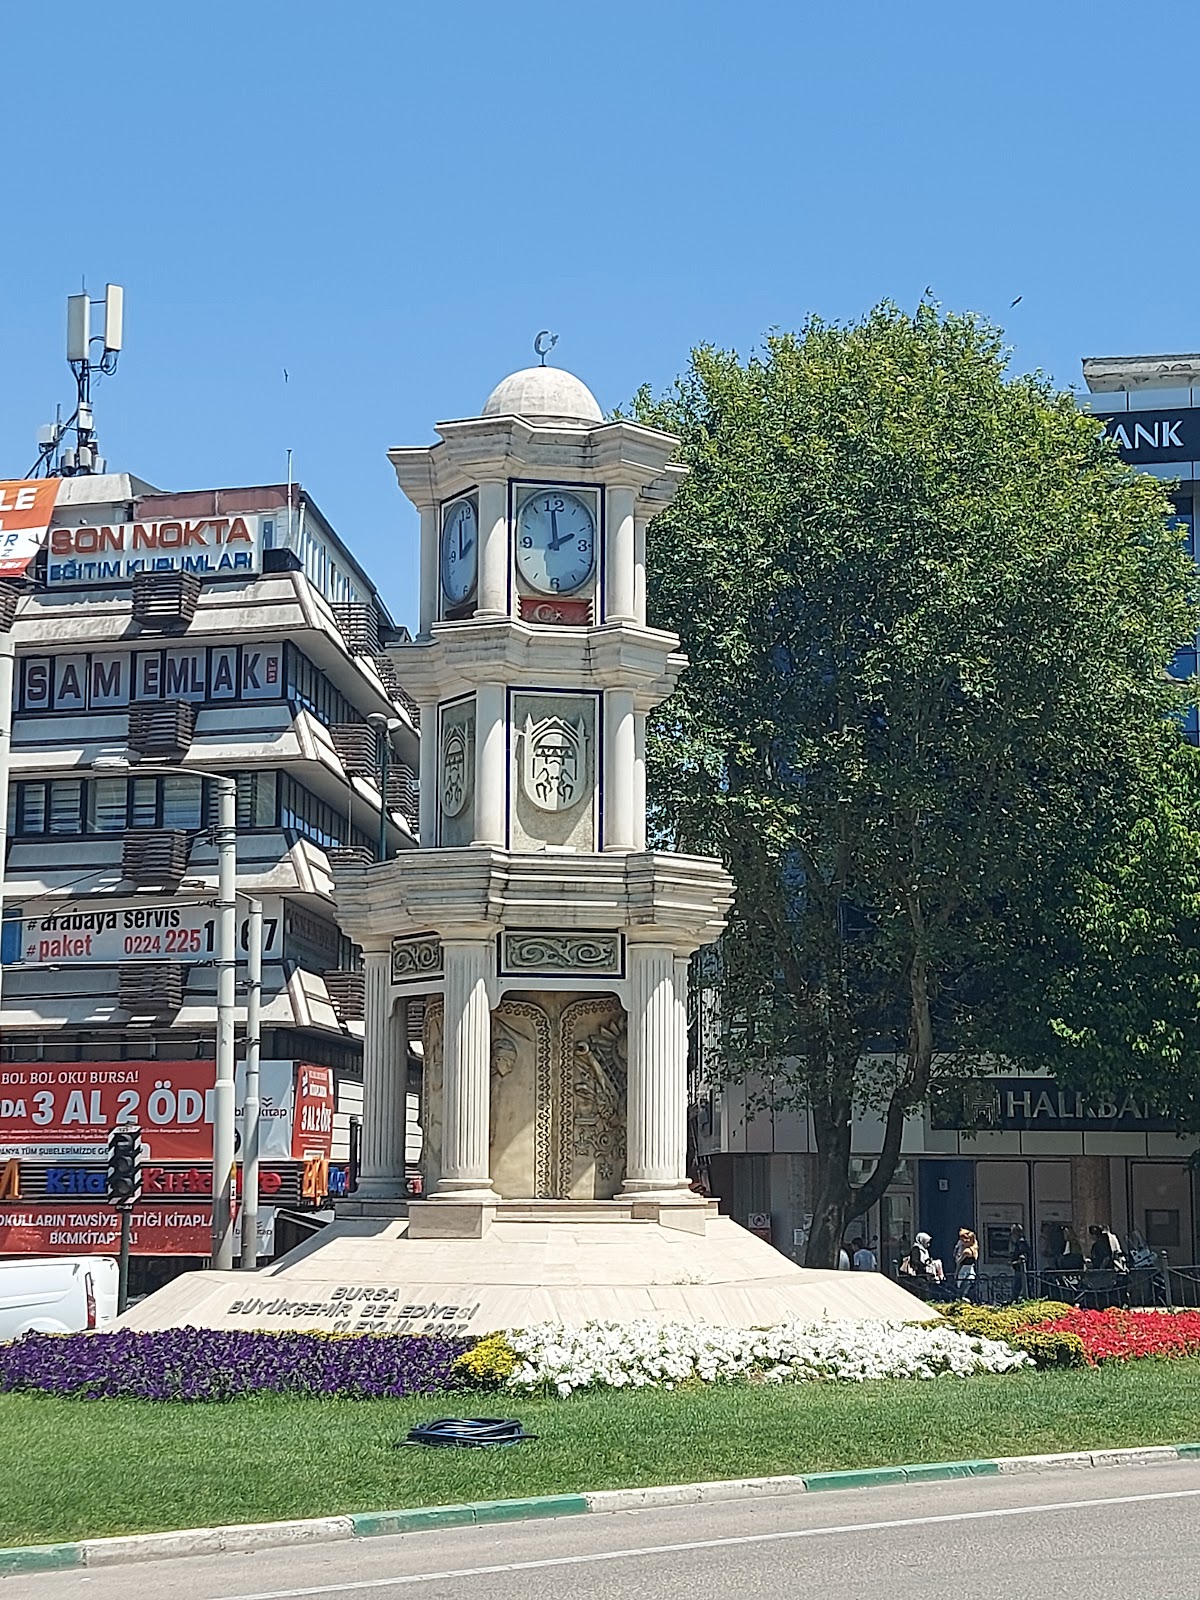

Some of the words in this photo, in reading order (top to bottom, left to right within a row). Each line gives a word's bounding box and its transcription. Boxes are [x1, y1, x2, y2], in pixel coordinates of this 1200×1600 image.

[1098, 421, 1184, 449] ANK
[543, 499, 565, 513] 12
[51, 525, 125, 555] SON
[132, 517, 253, 550] NOKTA
[522, 536, 533, 549] 9
[577, 540, 588, 552] 3
[550, 577, 560, 590] 6
[27, 662, 121, 701] SAM
[144, 653, 261, 694] EMLAK
[39, 934, 92, 961] paket
[124, 936, 161, 954] 0224
[165, 929, 201, 953] 225
[1, 1073, 27, 1084] BOL
[30, 1072, 56, 1084] BOL
[58, 1072, 87, 1083] OKU
[90, 1071, 139, 1084] BURSA!
[32, 1090, 55, 1125] 3
[61, 1090, 107, 1124] AL
[116, 1090, 140, 1125] 2
[1006, 1090, 1149, 1119] HALKBA
[21, 1146, 38, 1156] TÜM
[45, 1168, 108, 1193] Kita
[68, 1211, 118, 1227] TAVSİYE
[128, 1211, 161, 1227] TTİĞİ
[331, 1286, 400, 1302] BURSA
[227, 1297, 353, 1318] BÜYÜKŞEHİR
[360, 1302, 480, 1321] BELEDİYESİ
